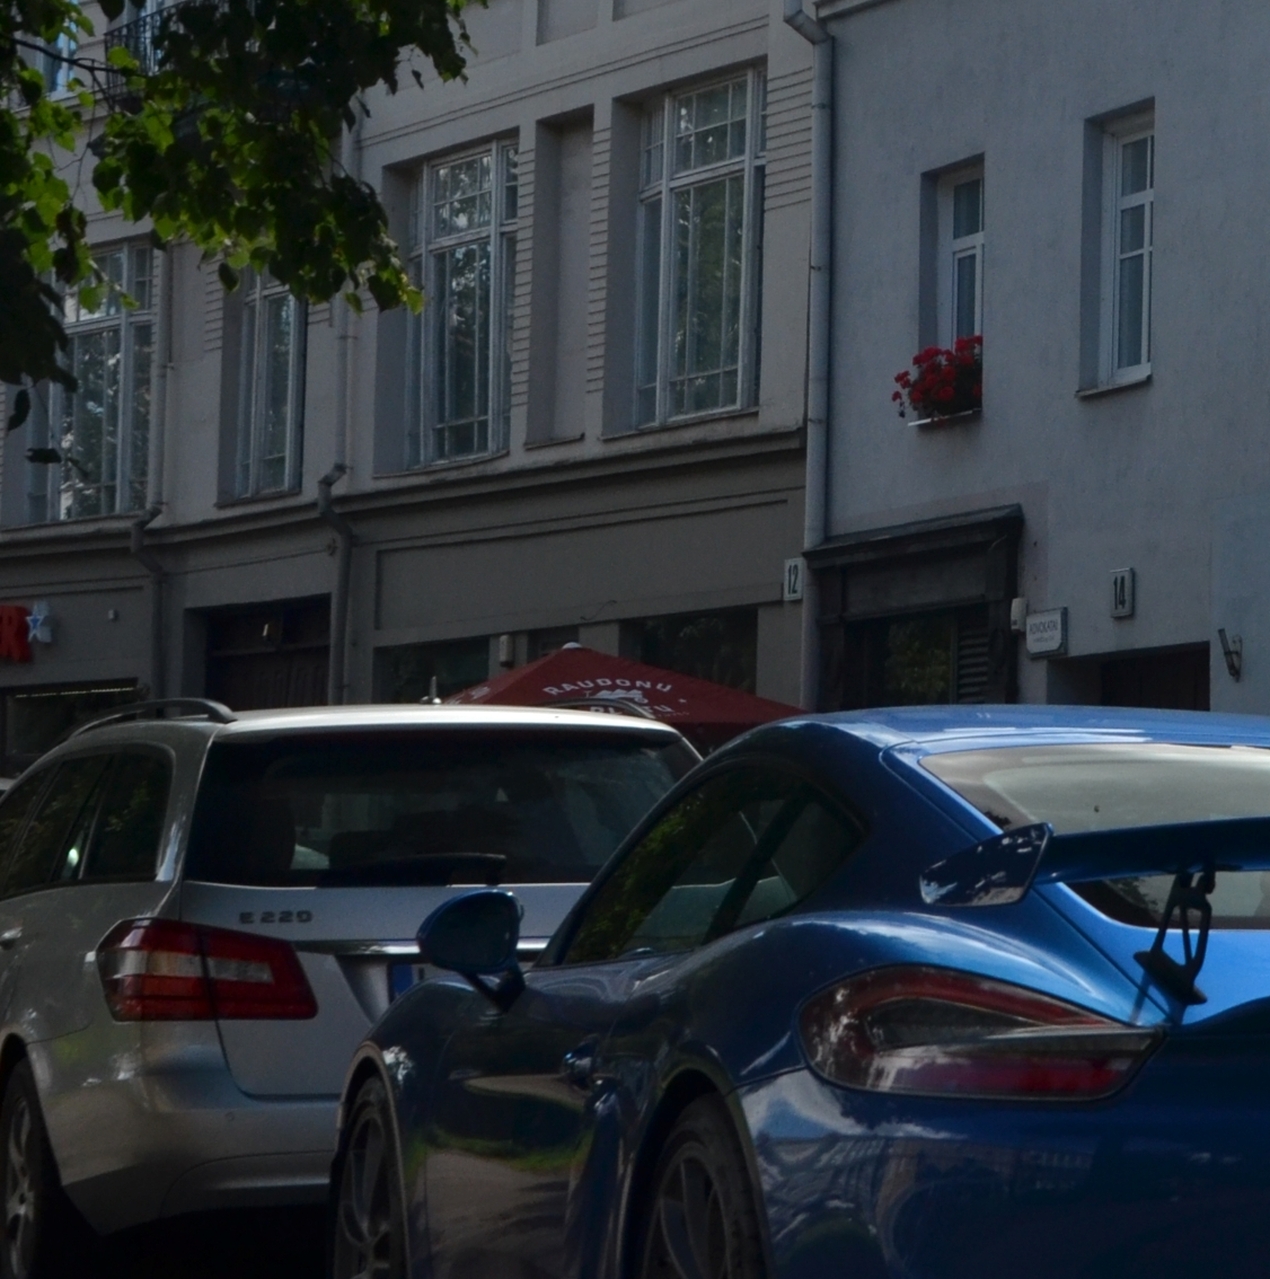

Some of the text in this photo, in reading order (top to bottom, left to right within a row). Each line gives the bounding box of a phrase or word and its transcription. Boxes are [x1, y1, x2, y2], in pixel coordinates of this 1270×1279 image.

[787, 563, 799, 595] 12
[1113, 574, 1126, 611] 14
[239, 909, 313, 924] E 220
